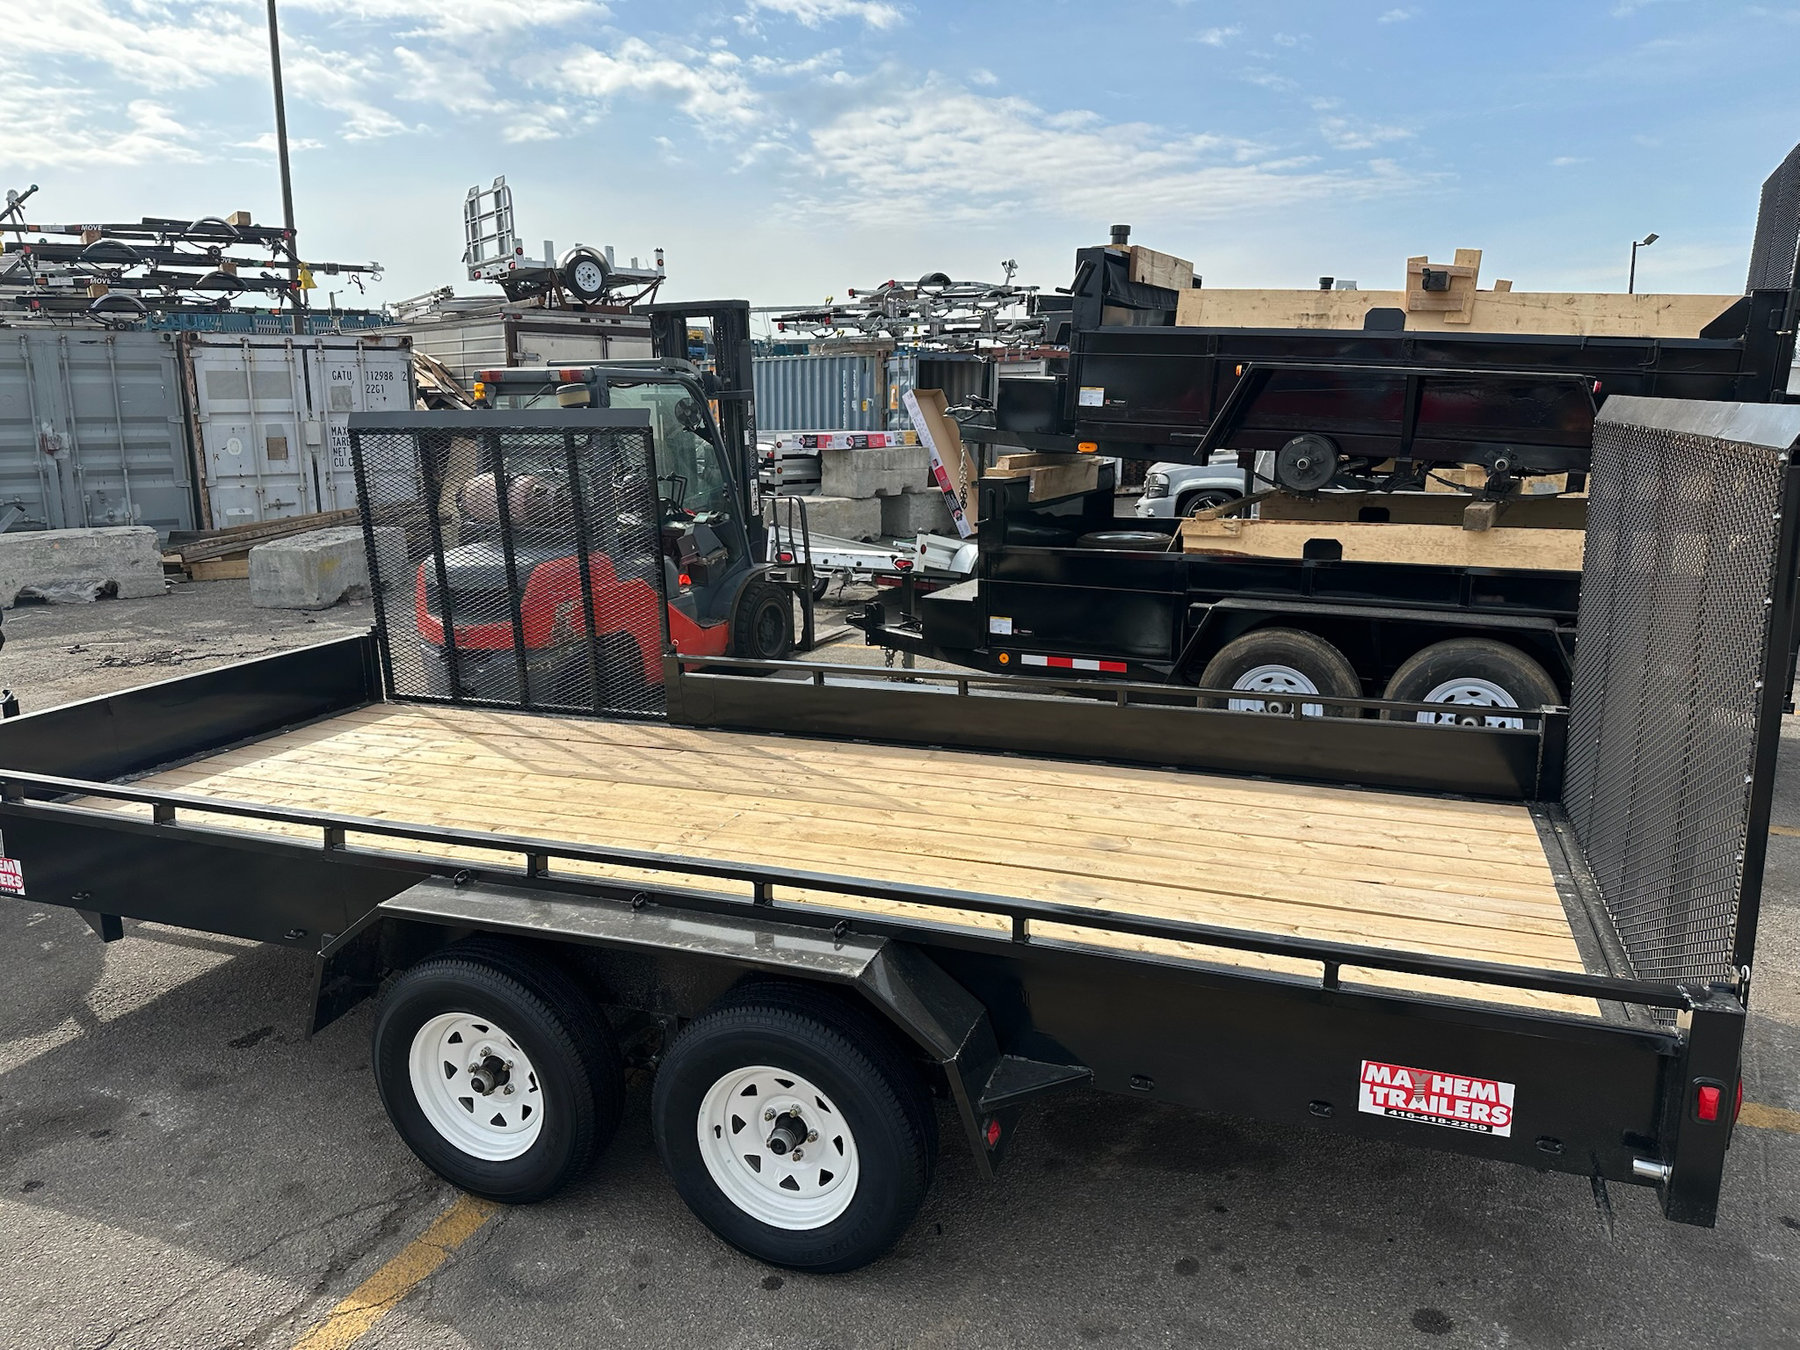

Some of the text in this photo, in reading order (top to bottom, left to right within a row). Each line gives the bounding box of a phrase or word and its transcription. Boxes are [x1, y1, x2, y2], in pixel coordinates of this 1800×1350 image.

[90, 277, 111, 285] MOVE
[331, 370, 407, 382] GATU 112988 2
[366, 384, 385, 394] 22G1
[333, 446, 347, 457] NET
[747, 417, 758, 477] TOYOTA
[1364, 1064, 1497, 1102] MAYHEM
[1372, 1085, 1509, 1125] TRAILERS
[1388, 1109, 1488, 1132] 416-418-2259
